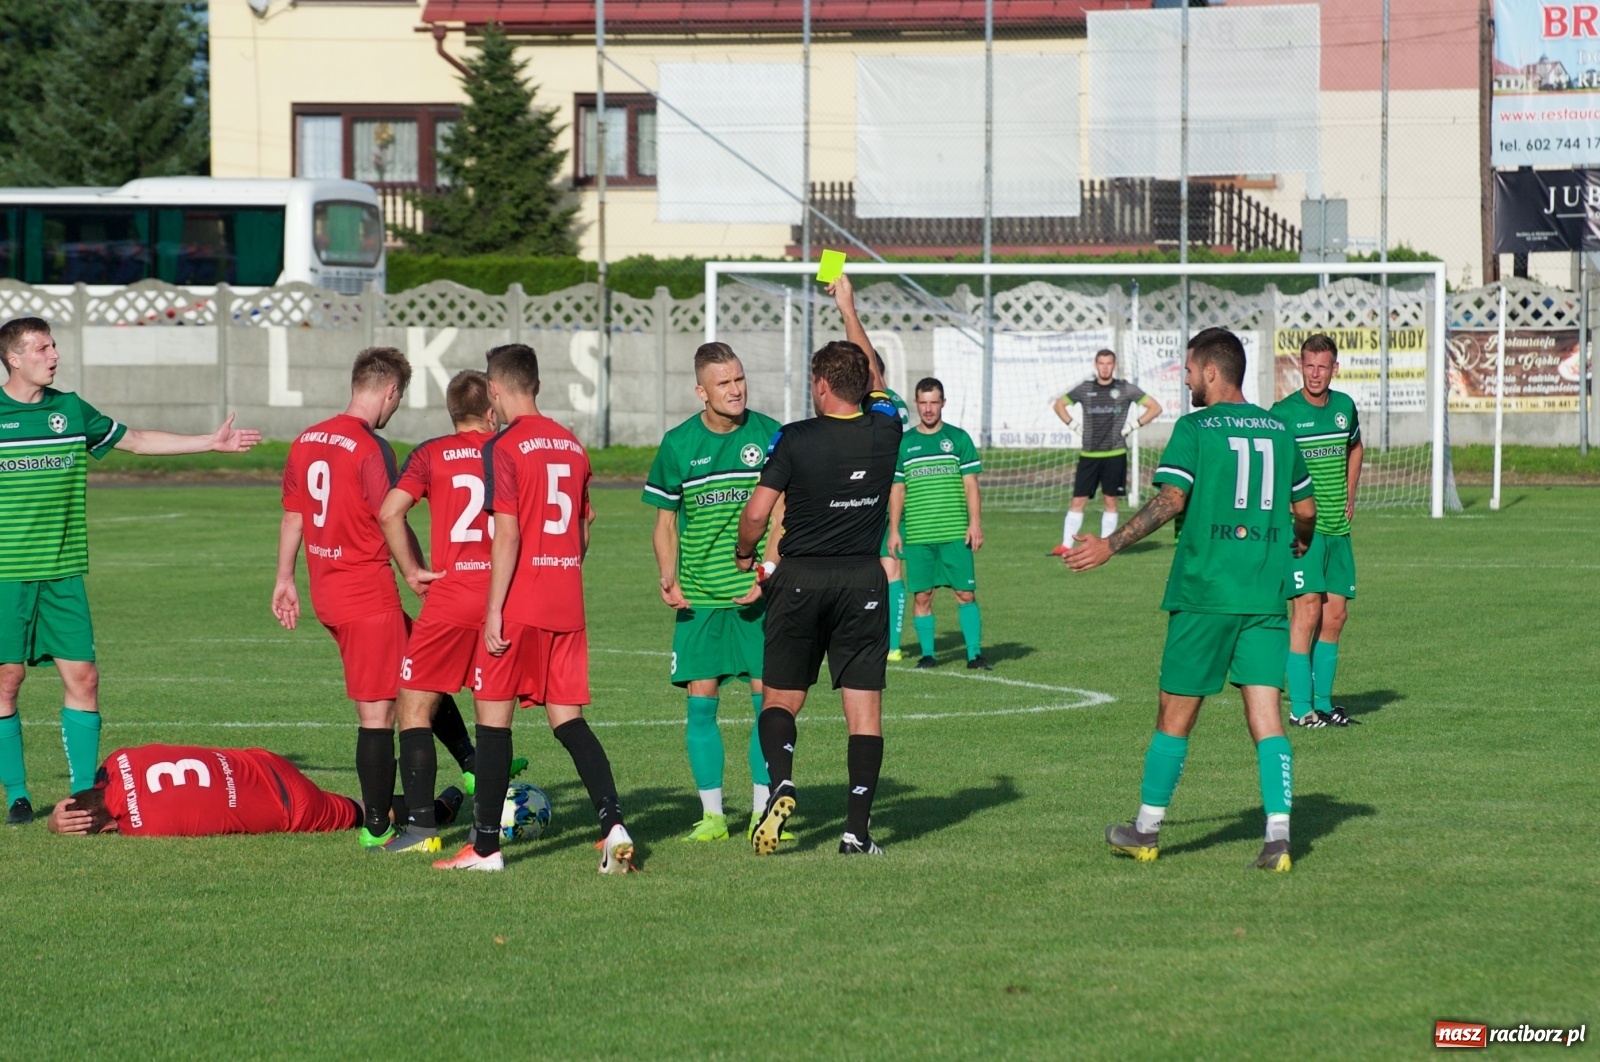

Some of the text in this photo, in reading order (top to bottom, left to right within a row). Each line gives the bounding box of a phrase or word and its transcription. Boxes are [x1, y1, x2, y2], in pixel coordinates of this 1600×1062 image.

[1500, 139, 1521, 152] tel.
[1526, 138, 1551, 151] 602
[1555, 137, 1580, 150] 744
[1227, 436, 1275, 510] 11
[307, 460, 330, 528] 9
[543, 463, 573, 536] 5
[1294, 570, 1304, 590] 5
[474, 667, 482, 691] 5
[145, 758, 211, 794] 3
